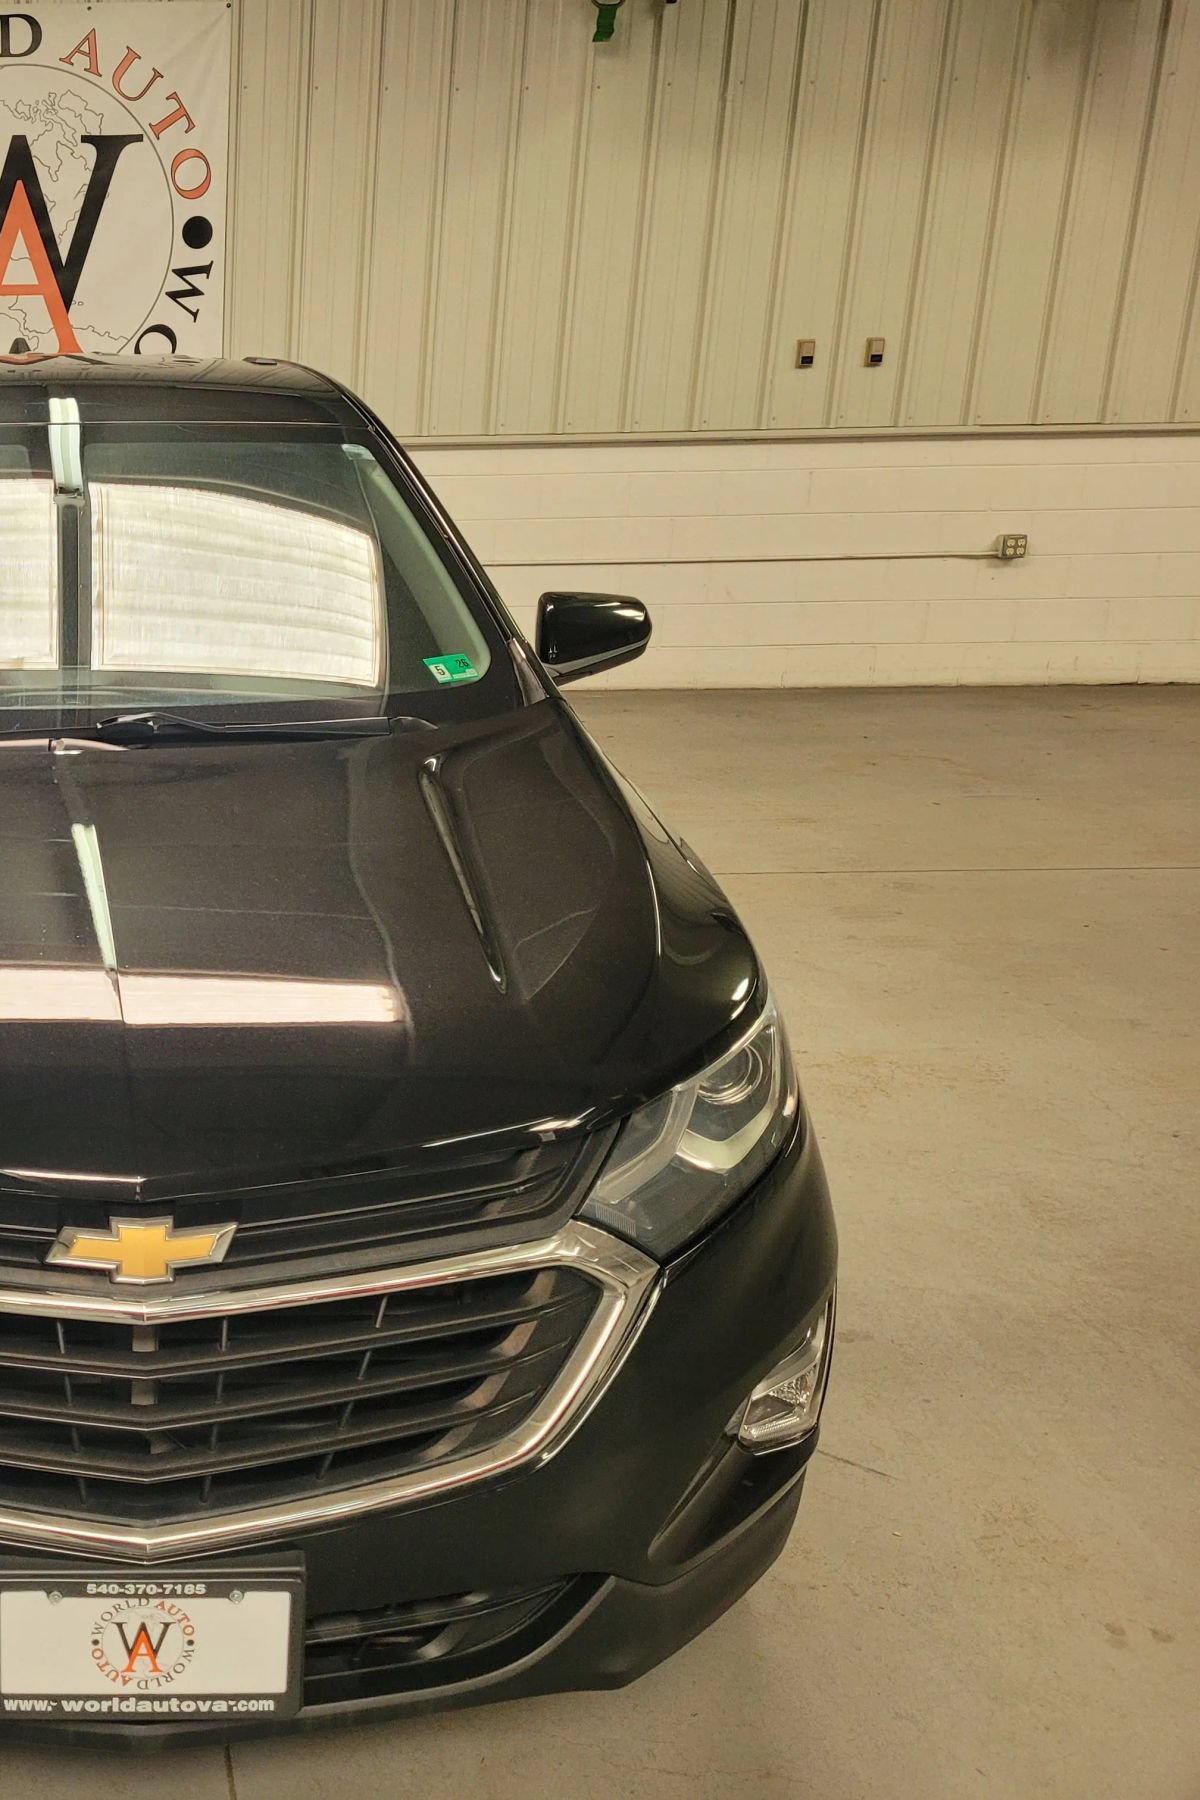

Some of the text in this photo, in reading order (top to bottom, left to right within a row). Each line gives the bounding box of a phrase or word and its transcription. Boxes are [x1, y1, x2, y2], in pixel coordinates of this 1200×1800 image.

[59, 28, 212, 199] AUTO
[434, 665, 446, 676] 5
[91, 1597, 195, 1637] WORLD AUTO
[91, 1647, 195, 1690] WORLD AUTO
